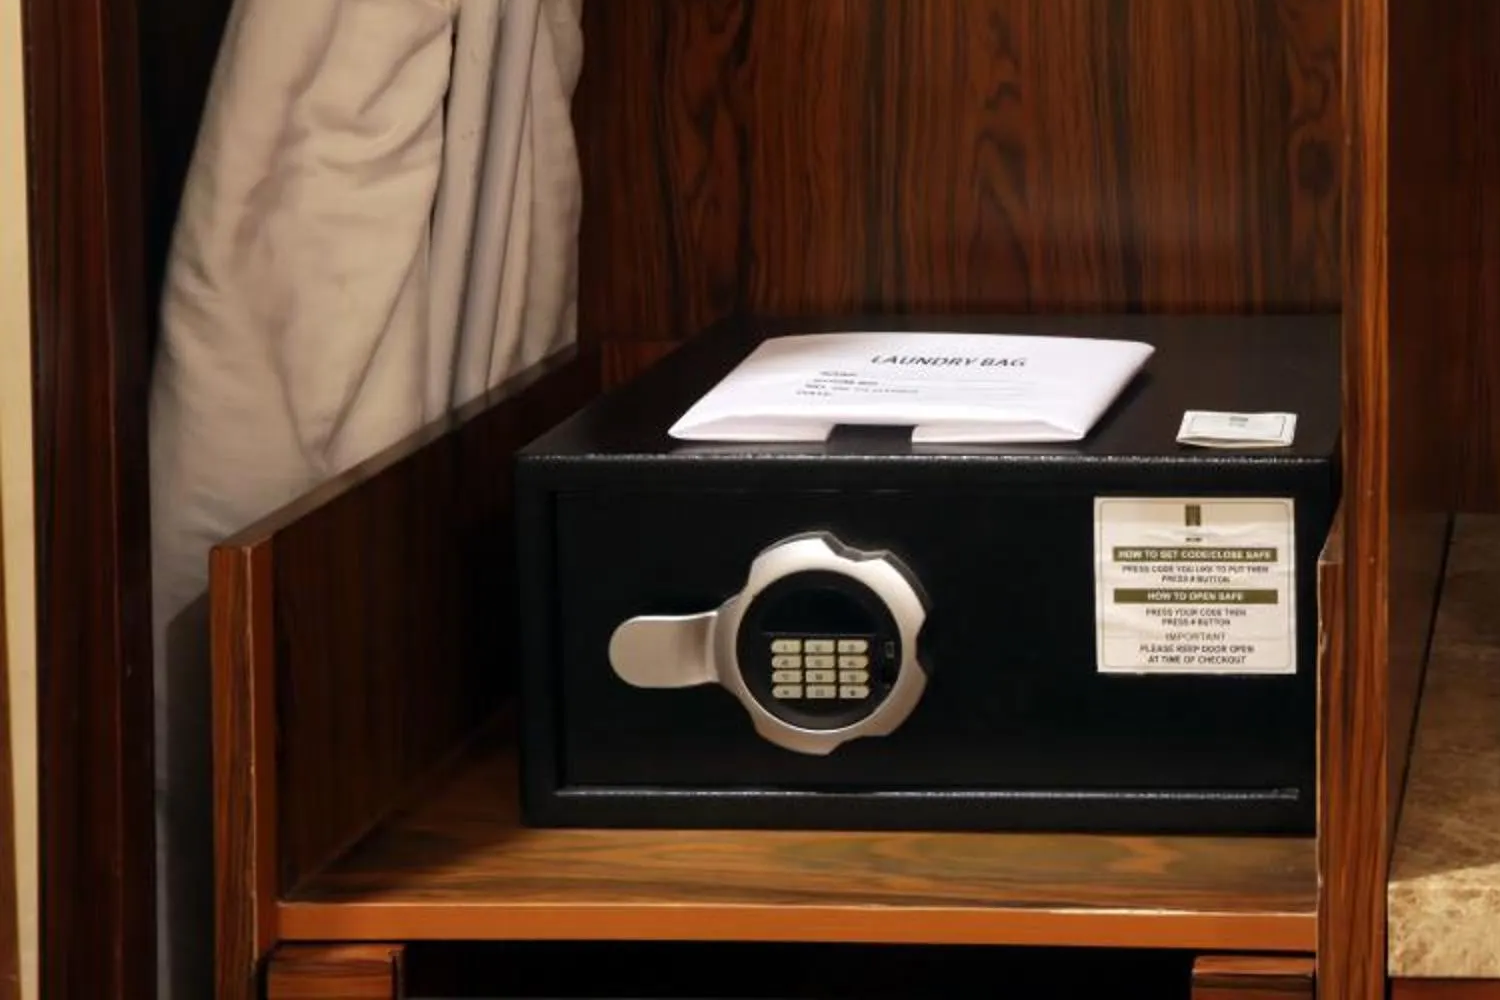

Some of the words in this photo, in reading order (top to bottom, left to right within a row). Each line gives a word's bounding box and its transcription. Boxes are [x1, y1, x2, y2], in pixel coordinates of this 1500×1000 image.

[871, 355, 978, 367] LAUNDRY
[980, 357, 1028, 367] BAG
[1118, 550, 1142, 560] HOW
[1145, 550, 1159, 560] TO
[1245, 551, 1272, 560] SAFE
[1121, 565, 1149, 574] PRESS
[1215, 565, 1227, 574] TO
[1161, 575, 1189, 584] PRESS
[1147, 591, 1171, 601] HOW
[1173, 591, 1187, 601] TO
[1189, 591, 1217, 601] OPEN
[1217, 591, 1244, 601] SAFE
[1145, 608, 1173, 617] PRESS
[1174, 608, 1198, 617] YOUR
[1199, 608, 1222, 617] CODE
[1161, 618, 1189, 627] PRESS
[1197, 618, 1231, 627] BUTTON
[1165, 632, 1226, 641] IMPORTANT
[1139, 644, 1174, 653] PLEASE
[1176, 645, 1201, 653] KEEP
[1201, 645, 1226, 653] DOOR
[1229, 645, 1255, 653] OPEN
[1147, 655, 1159, 664] AT
[1160, 655, 1181, 664] TIME
[1183, 655, 1196, 664] OF
[1197, 655, 1247, 665] CHECKOUT
